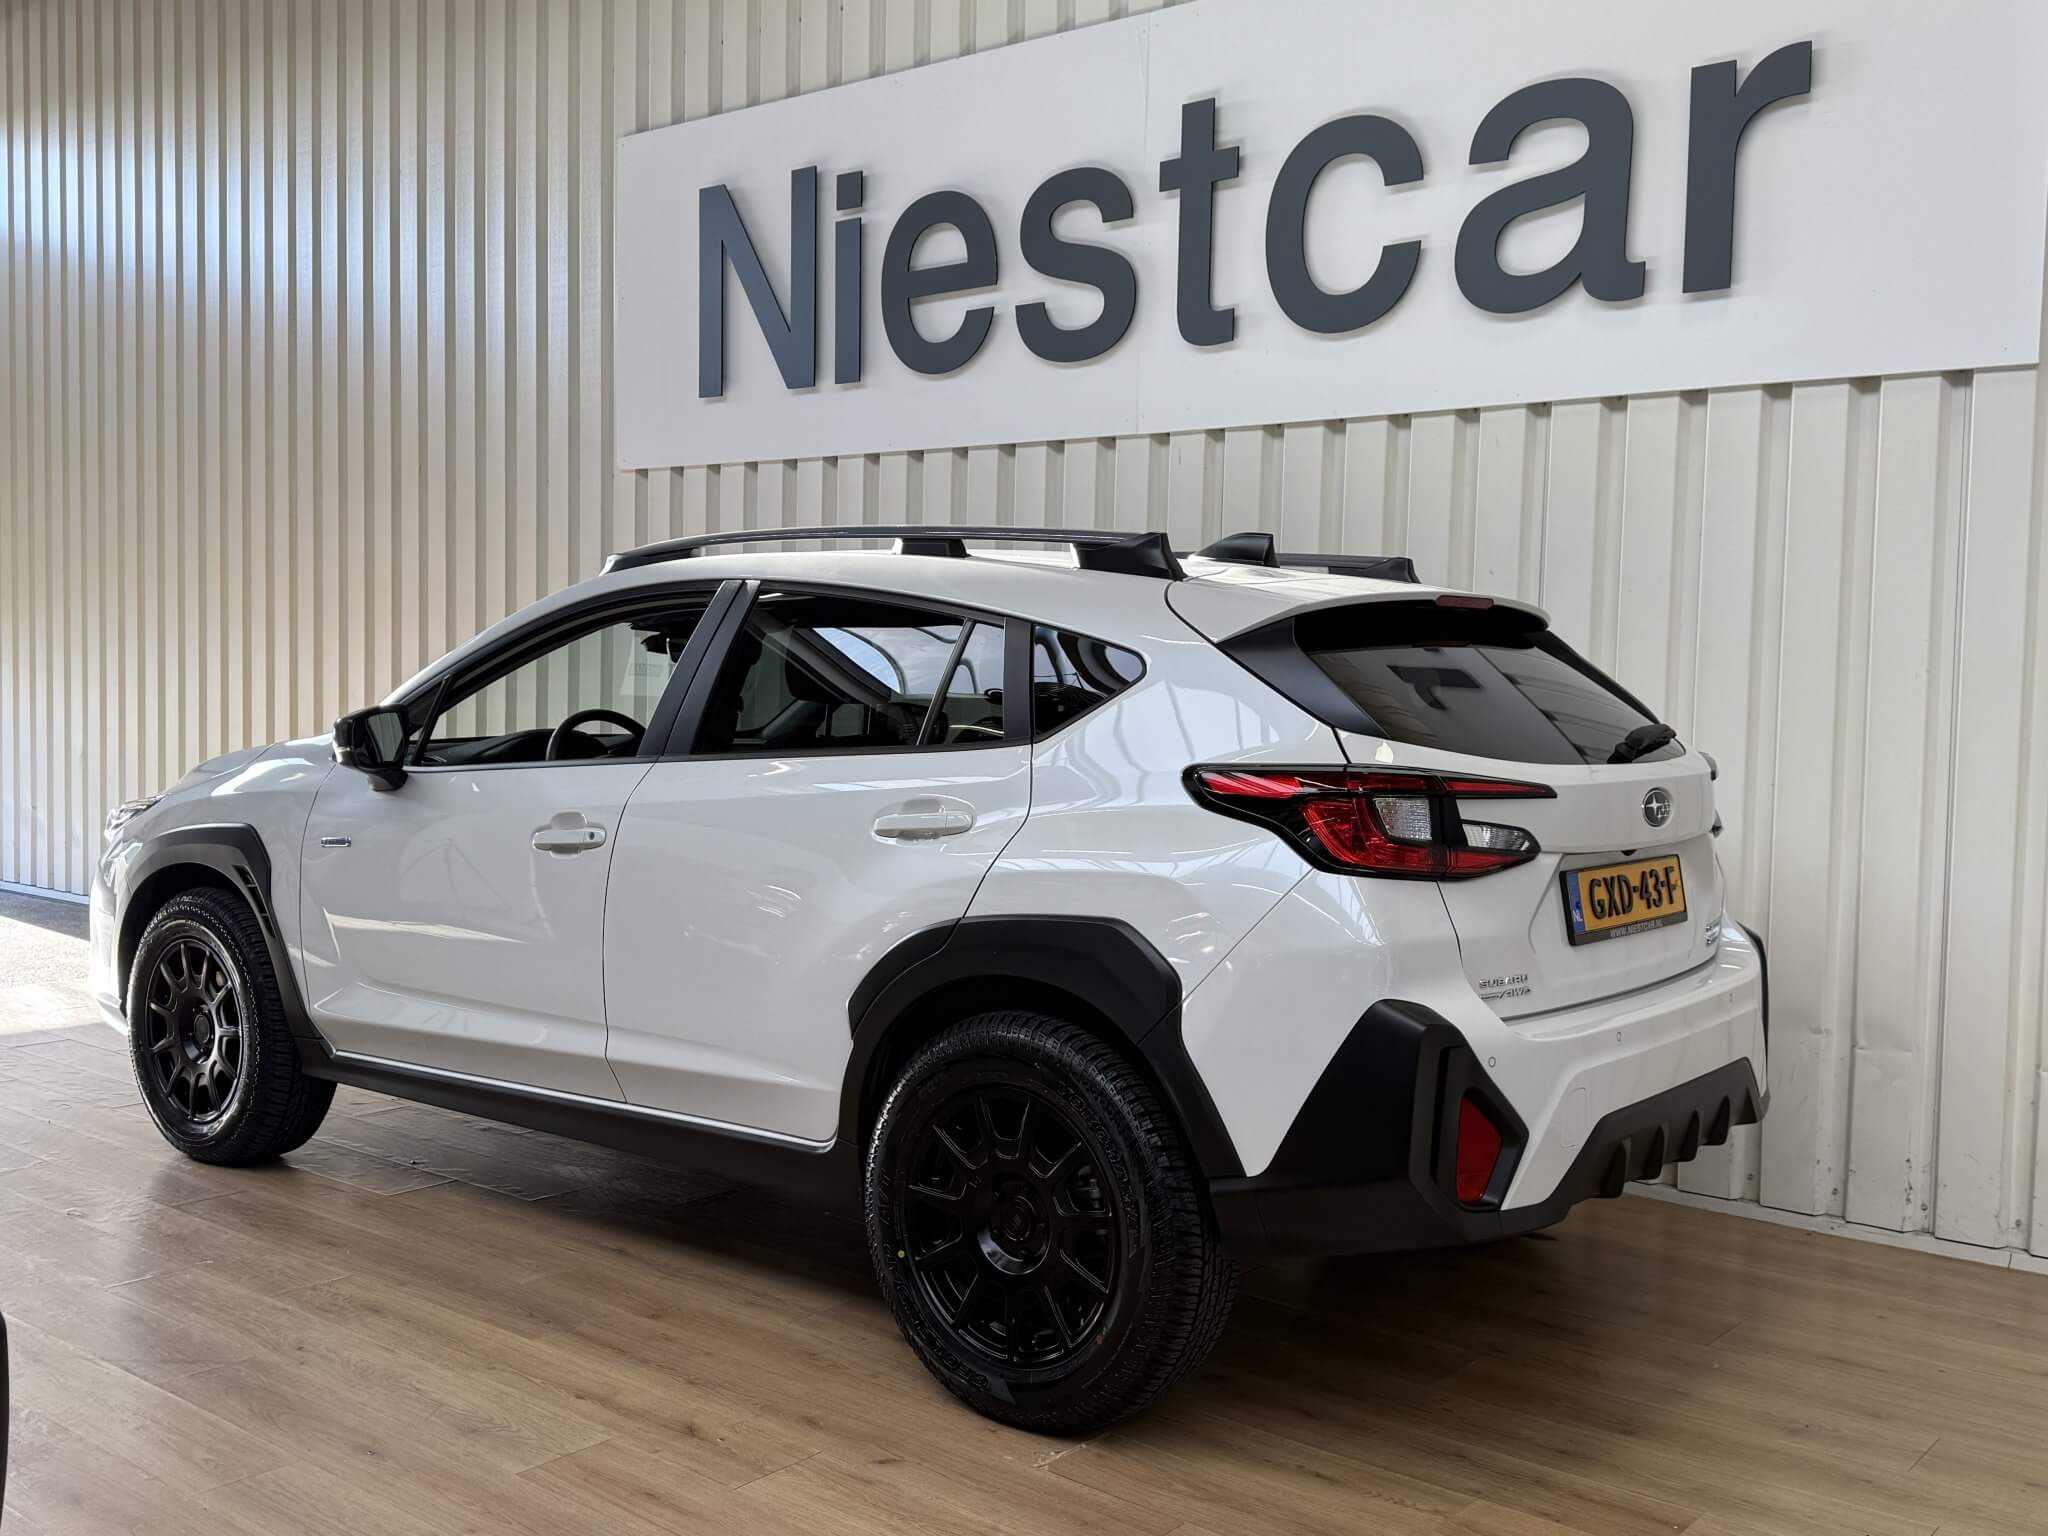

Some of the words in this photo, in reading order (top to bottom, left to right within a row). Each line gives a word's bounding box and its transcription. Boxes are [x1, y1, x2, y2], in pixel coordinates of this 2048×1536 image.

[698, 40, 1813, 399] Niestcar
[1589, 866, 1676, 920] GXD-43-F
[1573, 909, 1584, 923] NL
[1479, 973, 1529, 989] SUBARU
